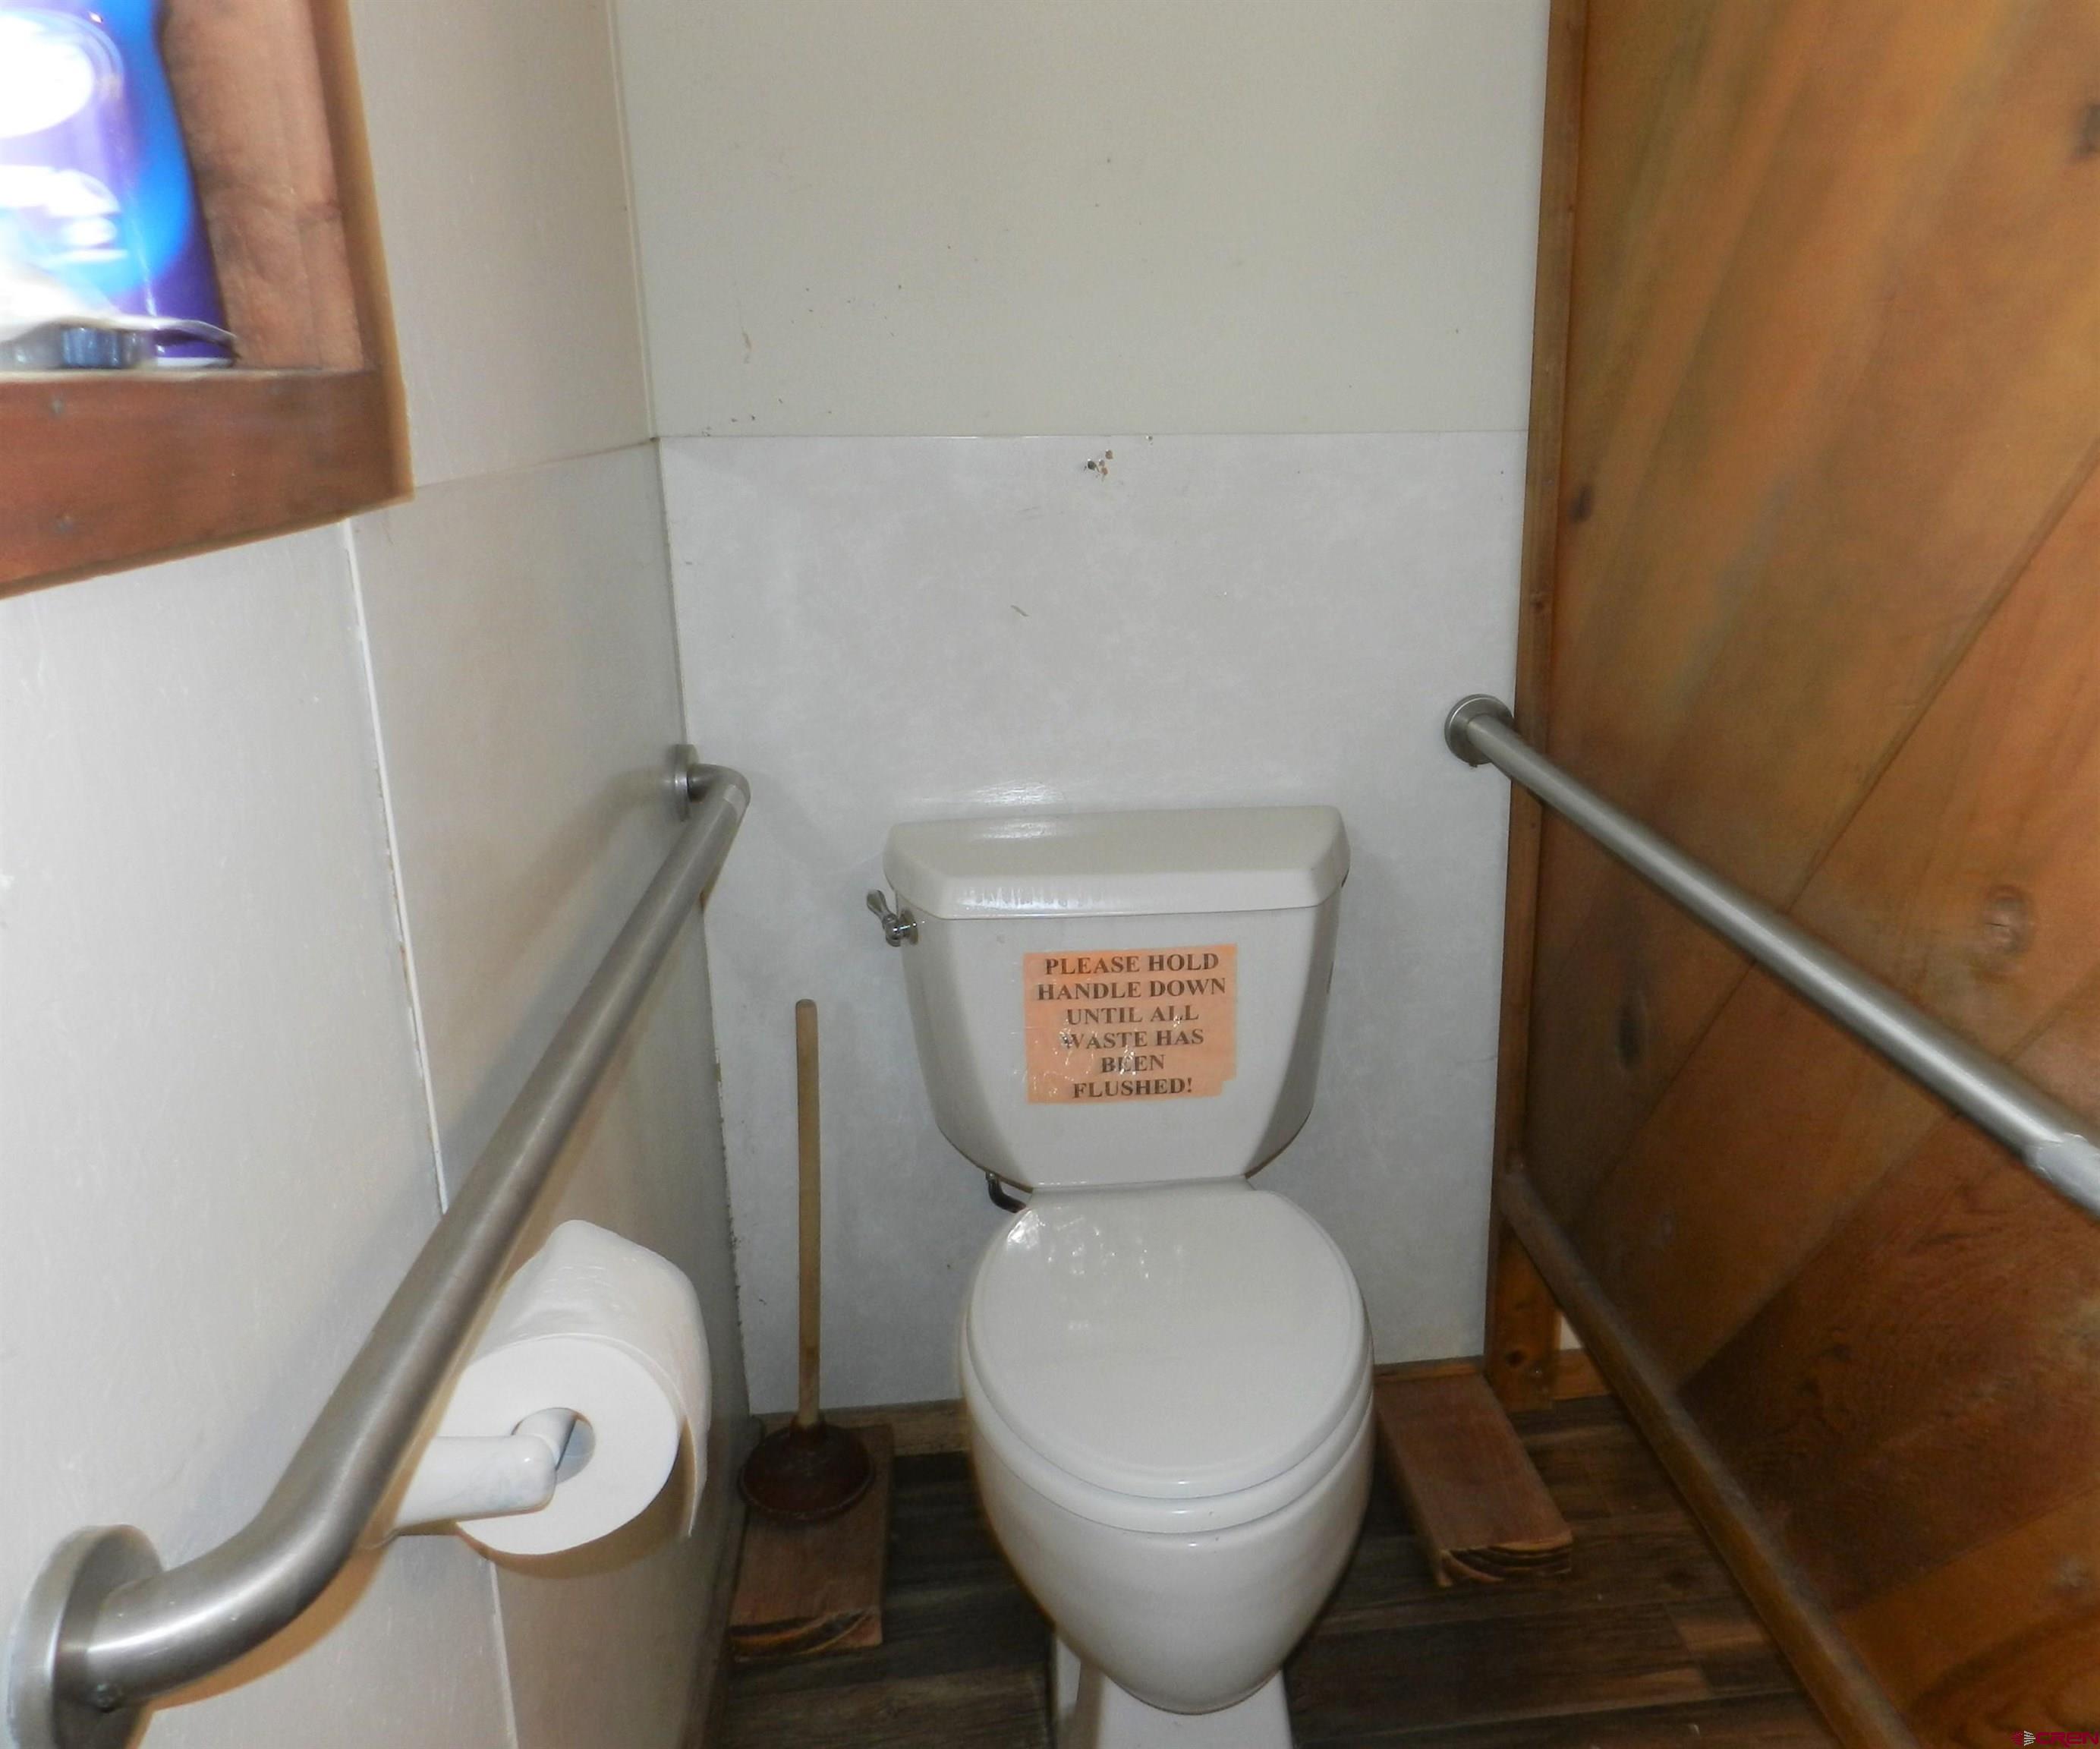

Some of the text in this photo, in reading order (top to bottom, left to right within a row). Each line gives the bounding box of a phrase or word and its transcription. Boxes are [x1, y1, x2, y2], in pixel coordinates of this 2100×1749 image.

[1045, 953, 1219, 975] PLEASE HOLD
[1037, 978, 1226, 1001] HANDLE DOWN
[1066, 1005, 1199, 1025] UNTIL ALL
[1061, 1029, 1204, 1049] WASTE HAS
[1072, 1077, 1193, 1098] FLUSHED!
